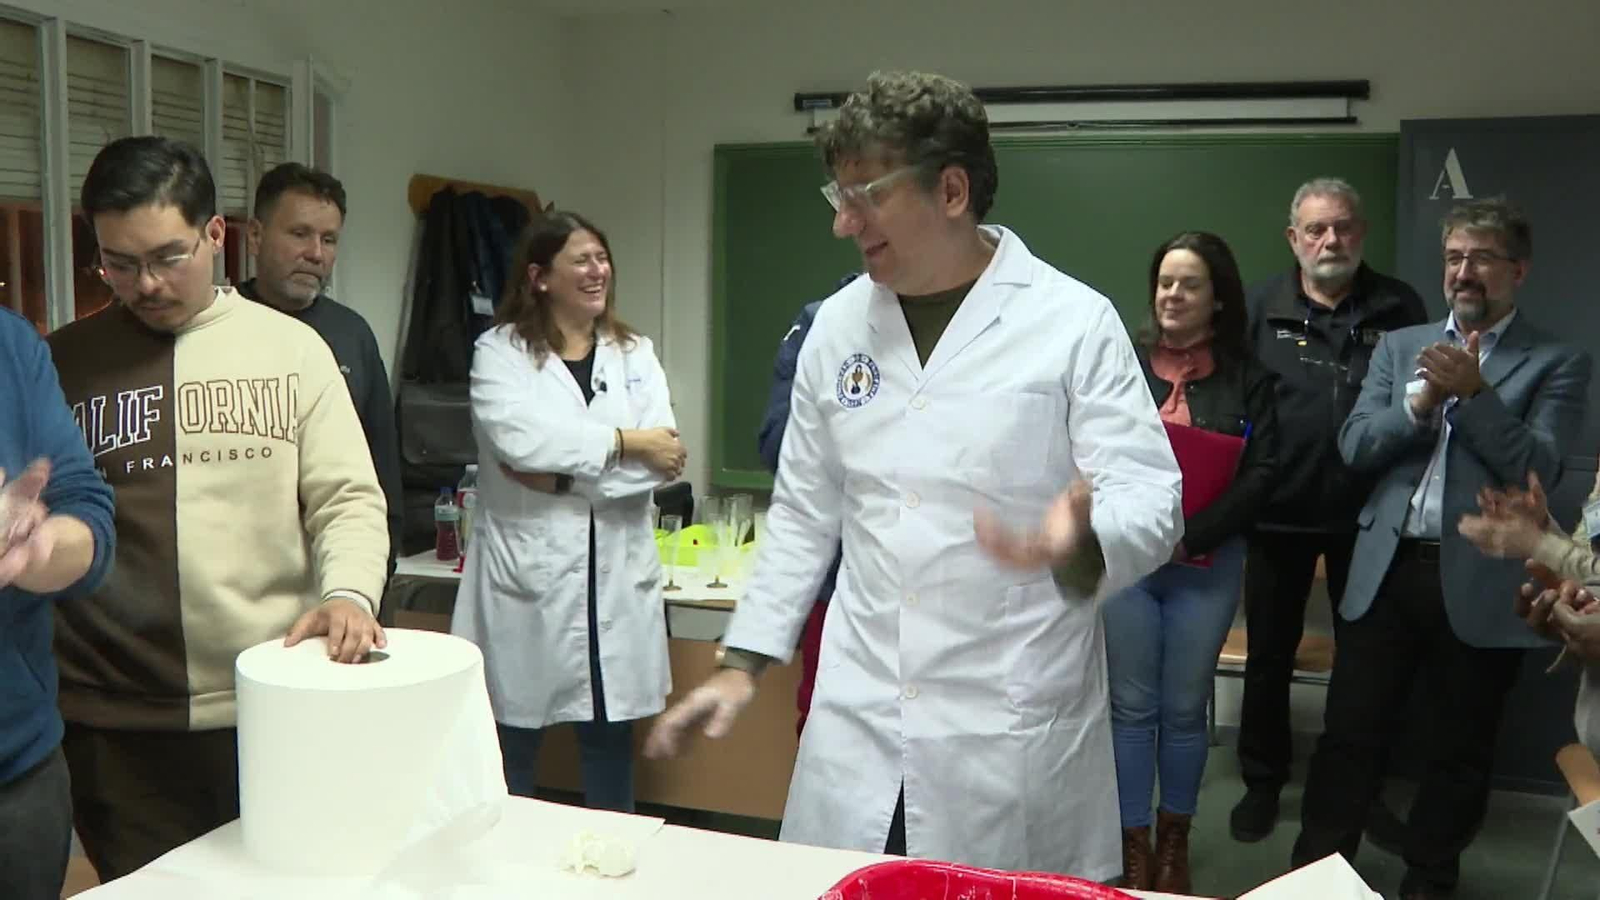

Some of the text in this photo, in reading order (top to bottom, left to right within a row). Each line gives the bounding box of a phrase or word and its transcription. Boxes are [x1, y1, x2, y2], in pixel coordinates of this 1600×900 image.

[1428, 147, 1473, 200] A
[73, 373, 299, 457] ALIFORNIA
[126, 447, 272, 474] FRANCISCO
